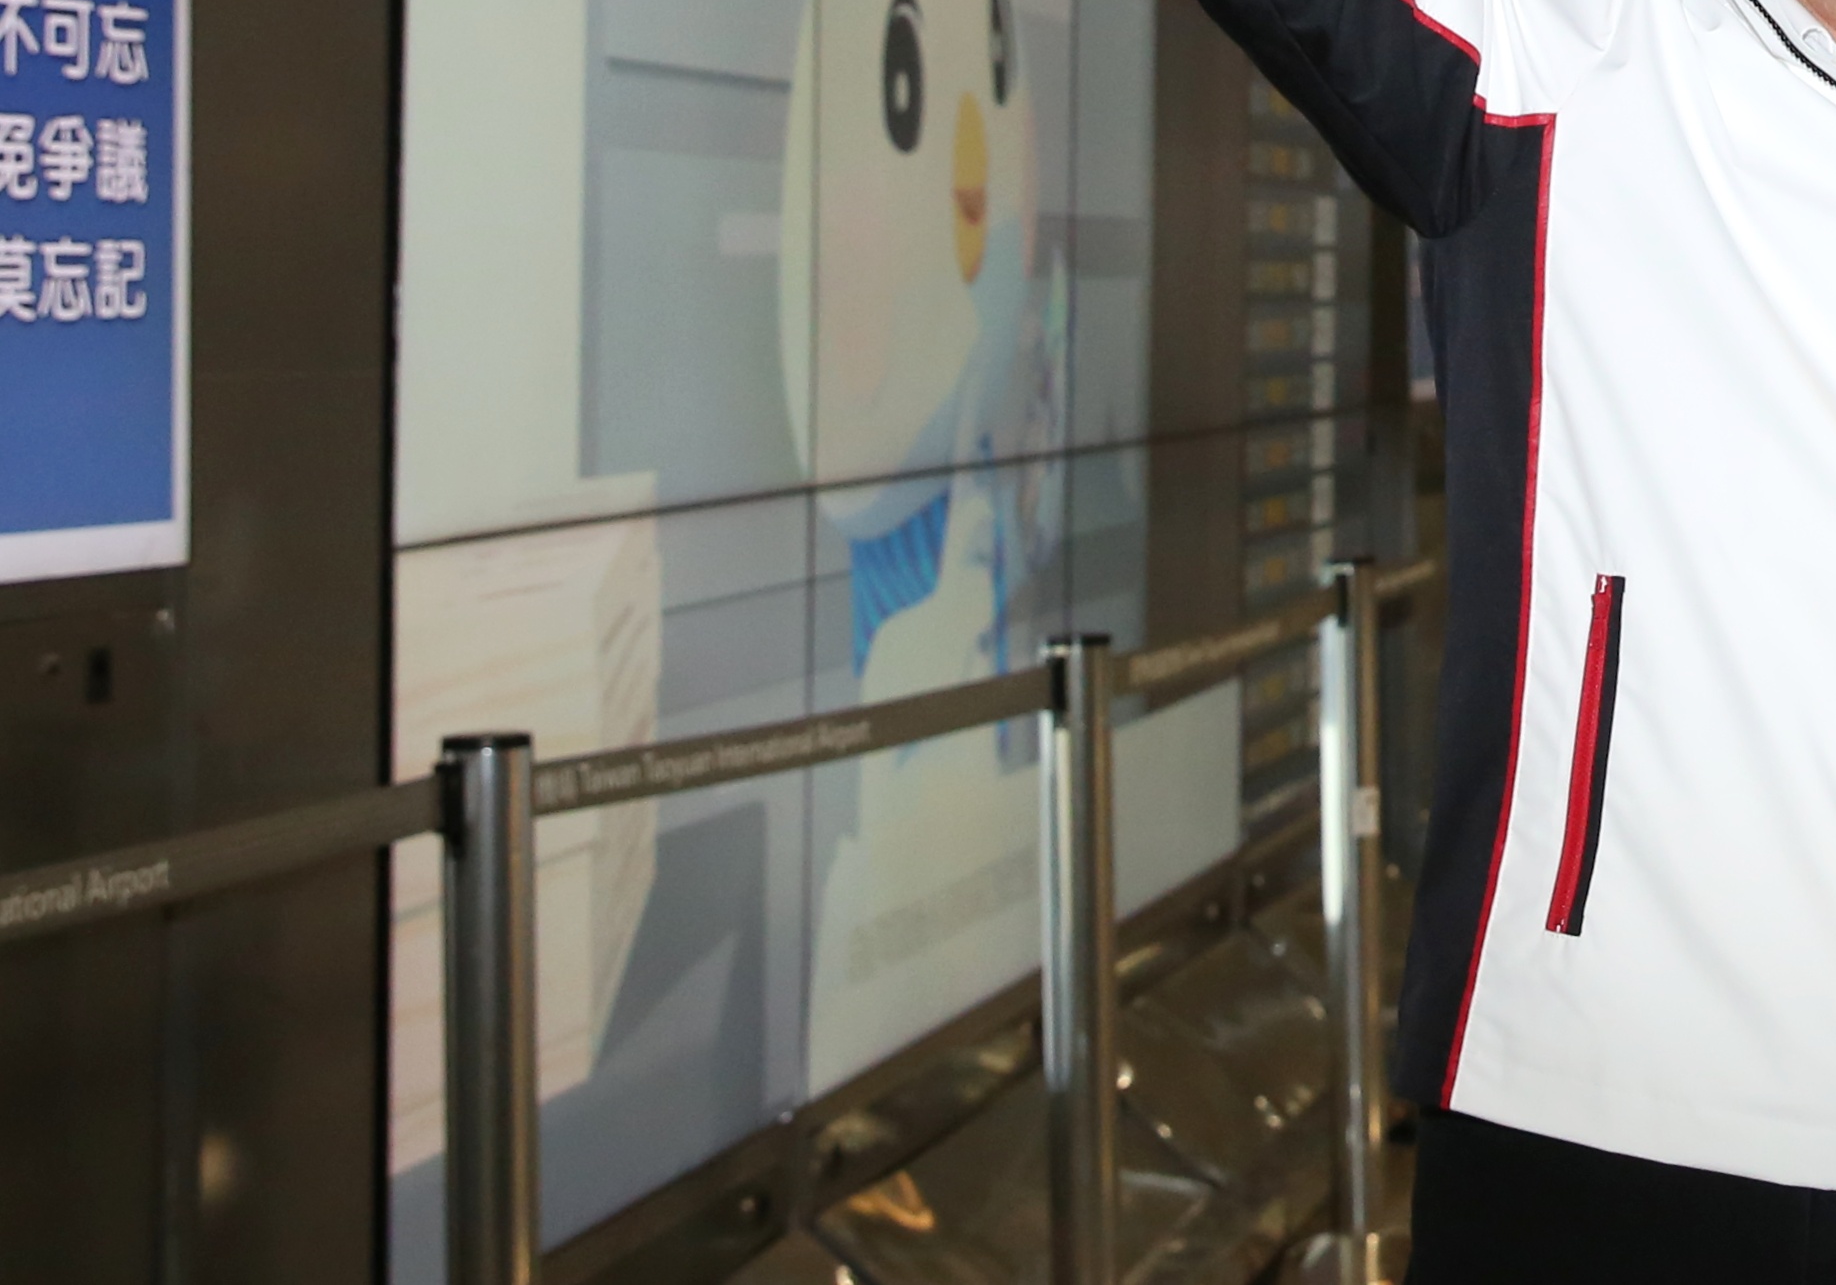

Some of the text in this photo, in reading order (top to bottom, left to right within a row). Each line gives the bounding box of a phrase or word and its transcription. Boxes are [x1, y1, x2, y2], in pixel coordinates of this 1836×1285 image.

[0, 114, 148, 205] 免爭議
[0, 234, 147, 322] 莫忘記
[85, 860, 169, 908] Airport
